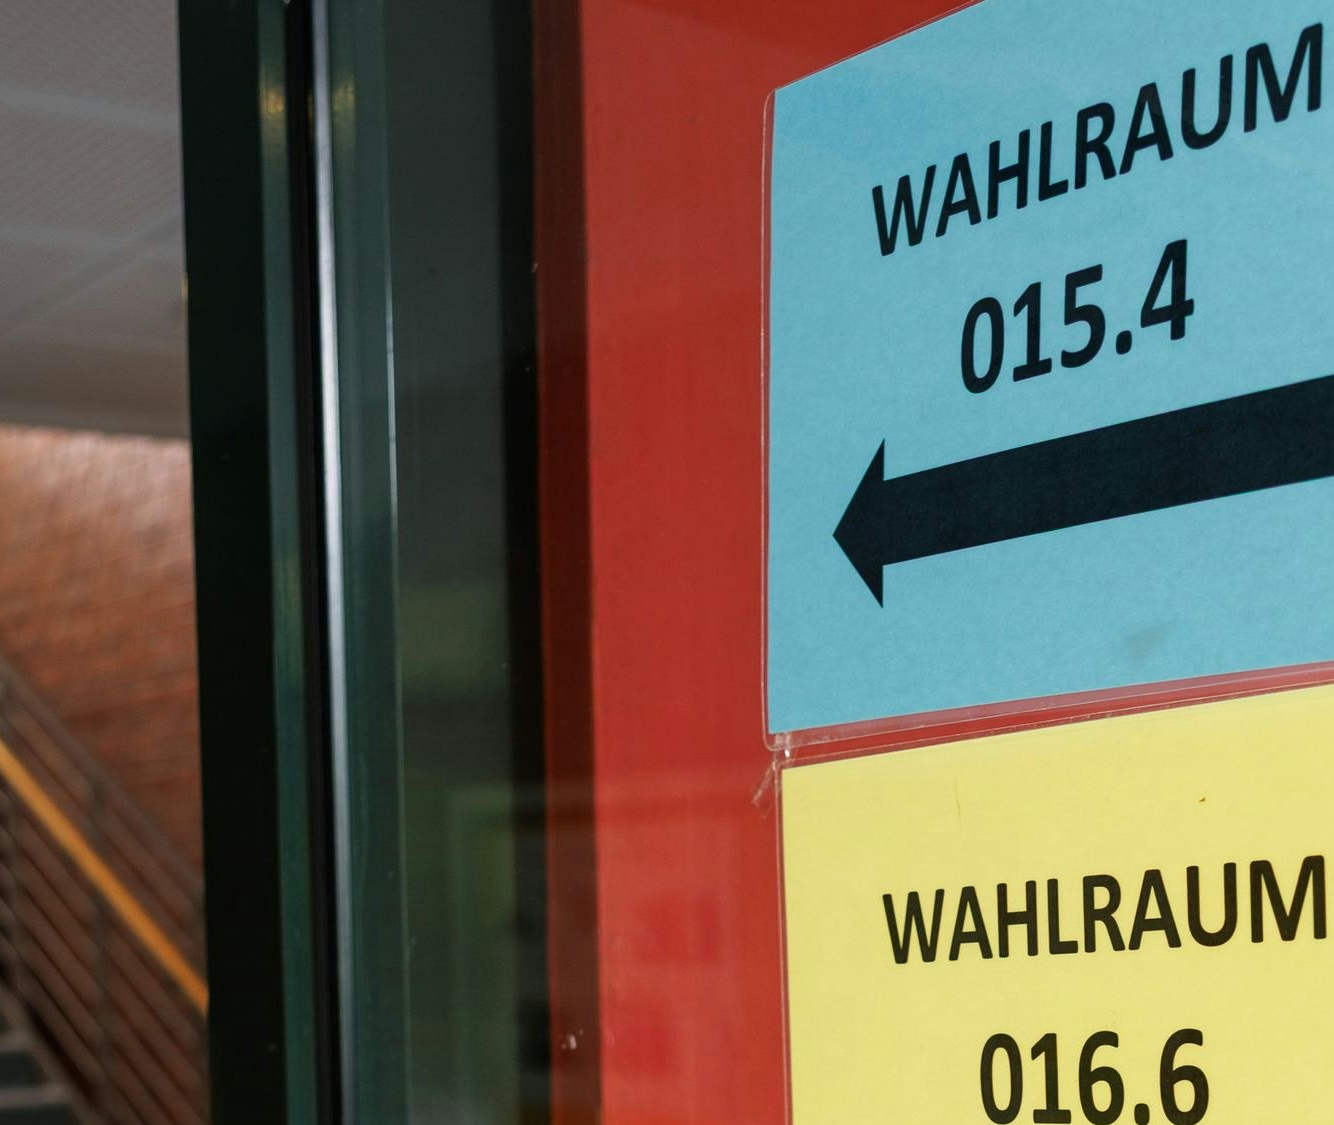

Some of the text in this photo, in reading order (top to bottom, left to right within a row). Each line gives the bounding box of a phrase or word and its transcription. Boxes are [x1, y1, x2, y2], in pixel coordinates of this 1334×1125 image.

[871, 22, 1325, 257] WAHLRAUM
[960, 238, 1195, 394] 015.4
[882, 855, 1327, 965] WAHLRAUM
